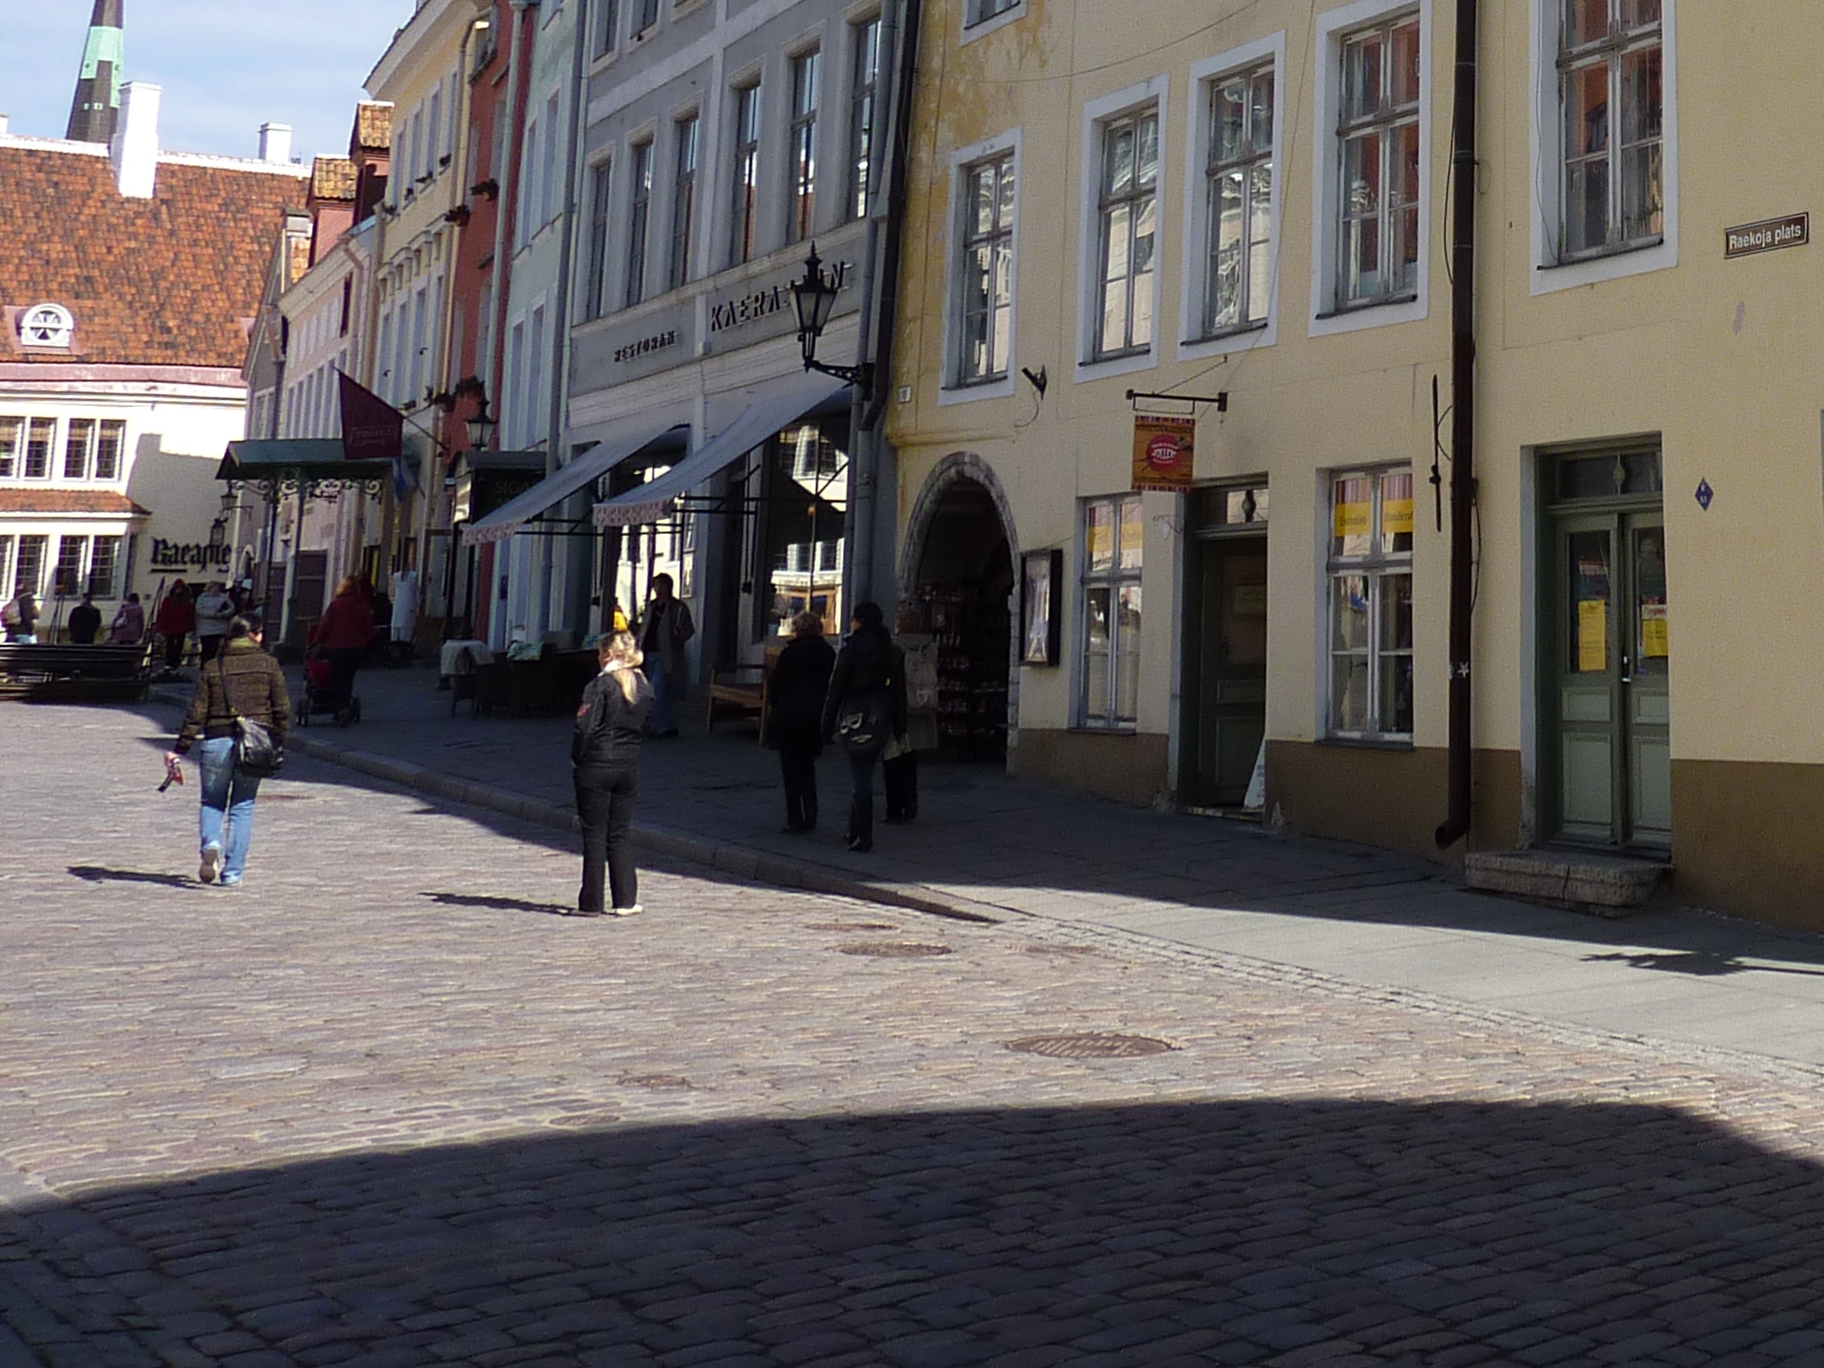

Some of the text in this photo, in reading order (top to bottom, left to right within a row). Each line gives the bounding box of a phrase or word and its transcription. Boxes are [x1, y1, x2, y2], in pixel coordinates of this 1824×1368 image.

[1729, 224, 1802, 250] Raekoja plats
[613, 329, 677, 363] RESTORAN
